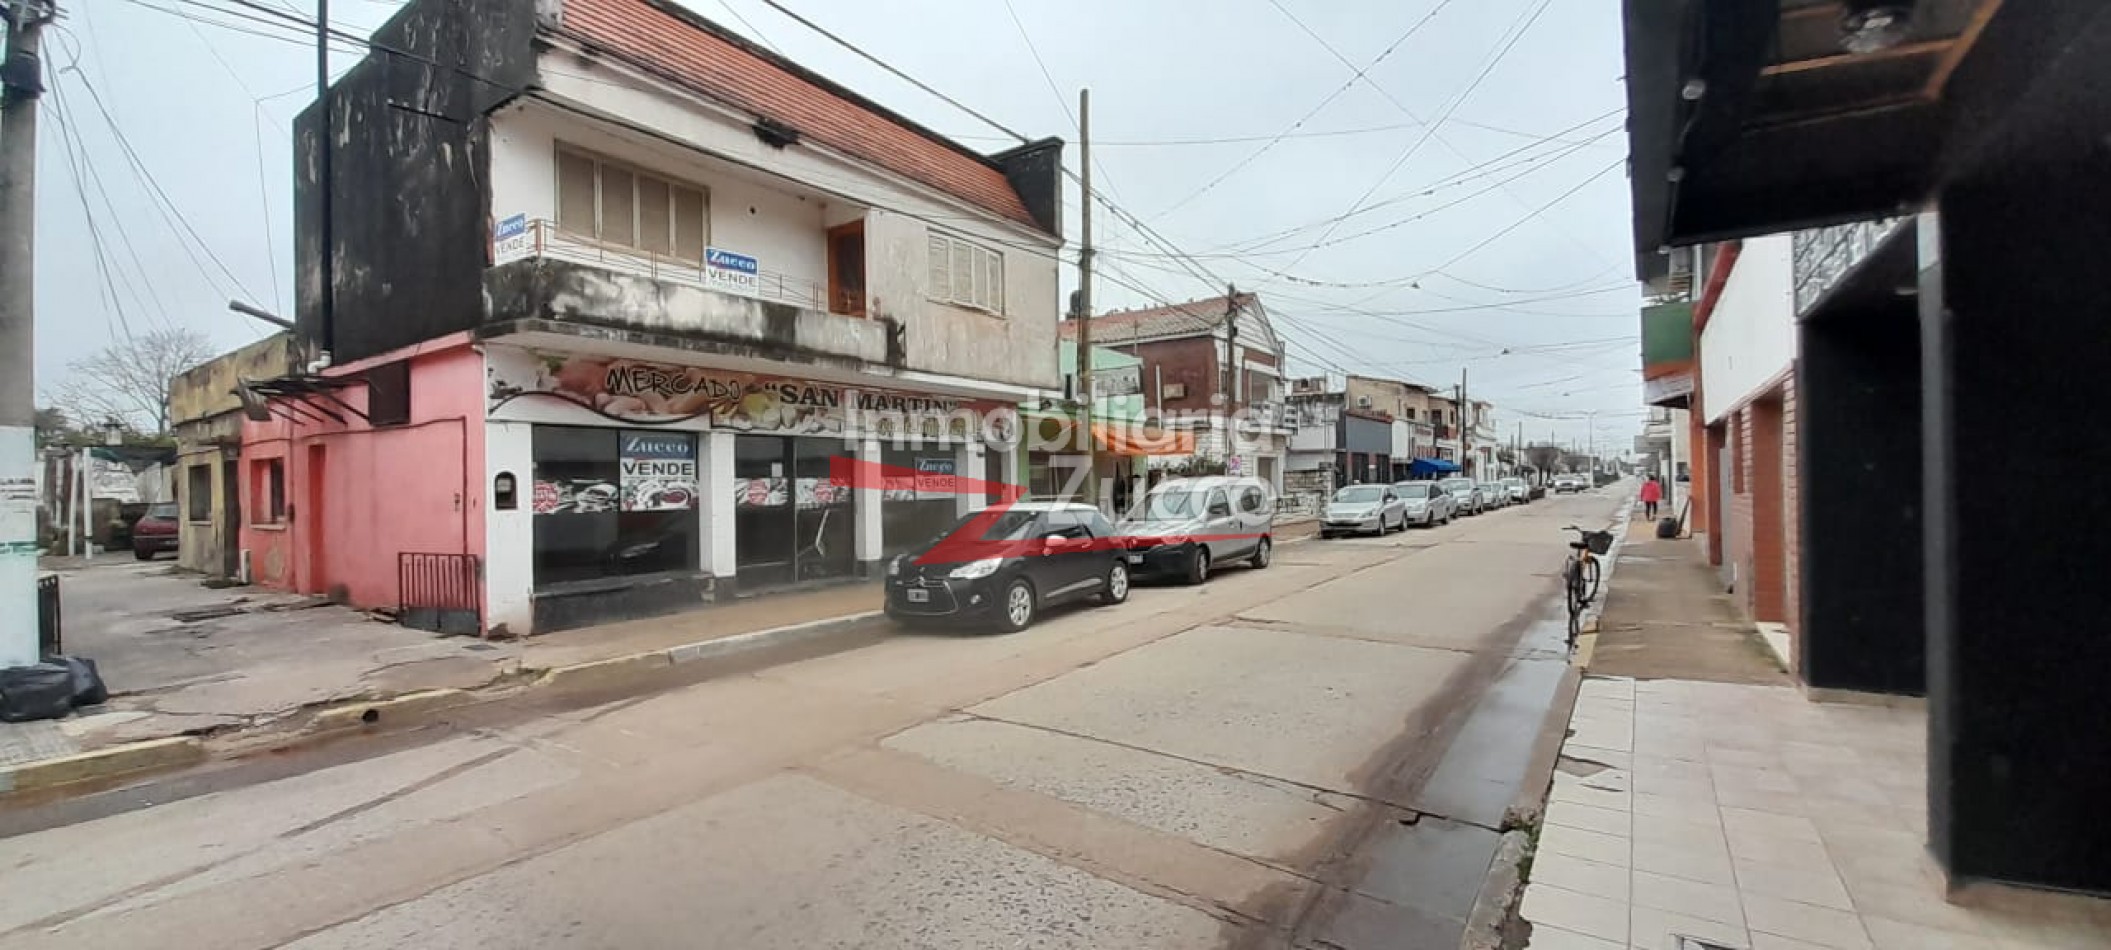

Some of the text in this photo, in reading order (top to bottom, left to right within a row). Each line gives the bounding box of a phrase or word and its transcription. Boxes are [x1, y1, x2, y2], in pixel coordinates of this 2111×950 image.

[709, 249, 756, 270] Zucco
[709, 267, 754, 285] VENDE
[607, 365, 741, 400] MERCADO
[626, 436, 689, 453] Zucco
[623, 462, 693, 476] VENDE
[918, 459, 953, 473] Zucco
[917, 477, 954, 488] VENDE
